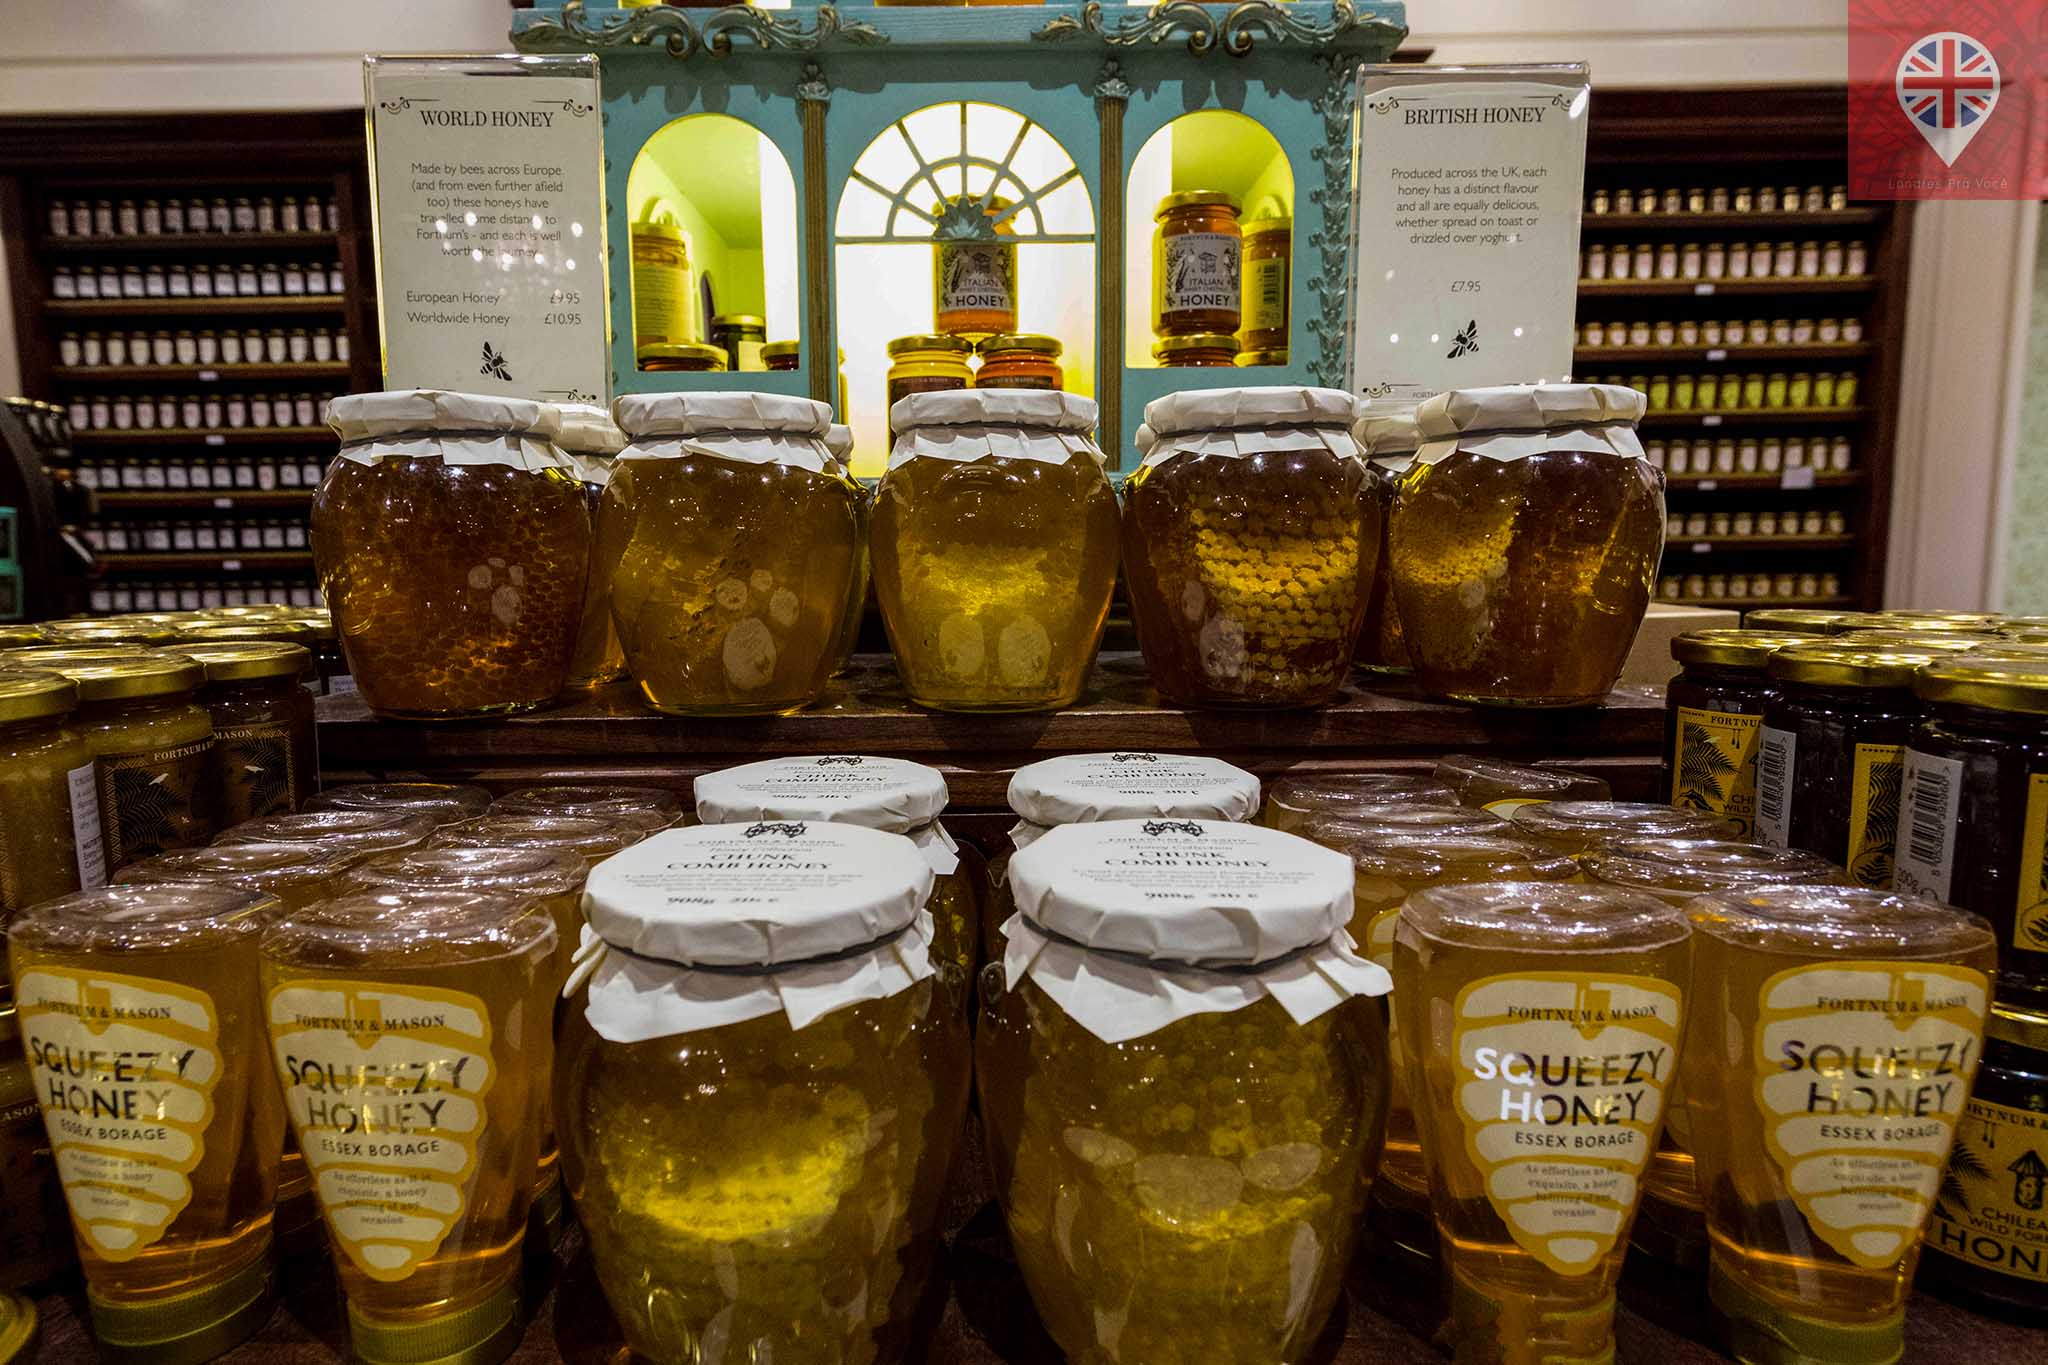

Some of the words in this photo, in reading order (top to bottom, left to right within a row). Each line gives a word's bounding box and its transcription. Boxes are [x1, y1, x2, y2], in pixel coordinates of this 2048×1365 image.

[420, 111, 487, 126] WORLD
[492, 111, 554, 127] HONEY
[1405, 108, 1478, 125] BRITISH
[1484, 107, 1546, 123] HONEY
[411, 163, 440, 175] Made
[445, 164, 457, 177] by
[460, 163, 484, 175] bees
[487, 166, 521, 176] across
[523, 164, 562, 178] Europe
[1391, 168, 1442, 179] Produced
[1446, 169, 1477, 178] across
[1481, 167, 1498, 177] the
[1502, 167, 1520, 178] UK,
[1523, 165, 1547, 177] each
[411, 179, 435, 192] (and
[438, 179, 463, 191] from
[467, 182, 492, 192] even
[494, 179, 531, 193] further
[535, 180, 564, 193] afield
[1398, 184, 1430, 198] honey
[1433, 184, 1451, 195] has
[1454, 186, 1461, 194] a
[1463, 183, 1501, 194] distinct
[1503, 182, 1539, 194] flavour
[427, 197, 450, 210] too)
[453, 196, 481, 208] these
[484, 196, 522, 211] honeys
[524, 197, 549, 209] have
[1396, 200, 1416, 211] and
[1419, 200, 1430, 211] all
[1433, 203, 1450, 211] are
[1453, 199, 1489, 213] equally
[1492, 199, 1540, 211] delicious,
[545, 216, 557, 225] to
[1396, 216, 1439, 228] whether
[1442, 217, 1477, 230] spread
[1479, 218, 1494, 227] on
[1497, 216, 1523, 227] toast
[1526, 217, 1539, 226] or
[479, 230, 500, 241] and
[502, 230, 528, 241] each
[530, 230, 537, 240] is
[539, 230, 561, 241] well
[1409, 232, 1450, 244] drizzled
[1453, 234, 1477, 243] over
[441, 245, 472, 257] worth
[478, 246, 495, 256] he
[964, 279, 999, 288] ITALIAN
[1188, 278, 1224, 287] ITALIAN
[1451, 280, 1481, 293] £7.95
[406, 290, 460, 304] European
[462, 291, 500, 306] Honey
[955, 294, 1006, 307] HONEY
[1179, 294, 1230, 307] HONEY
[406, 311, 470, 324] Worldwide
[473, 312, 511, 328] Honey
[544, 313, 582, 325] £10.95
[1731, 794, 1755, 805] CHI
[1722, 803, 1752, 814] WILD
[710, 853, 797, 861] CHUNK
[1138, 851, 1226, 859] CHUNK
[666, 862, 741, 870] COMB
[744, 861, 834, 870] HONEY
[1104, 859, 1179, 867] COMB
[1184, 859, 1272, 868] HONEY
[1816, 996, 1906, 1013] FORTNUM
[113, 1006, 172, 1020] MASON
[1507, 1006, 1592, 1022] FORTNUM
[1595, 1011, 1605, 1022] &
[1611, 1004, 1658, 1021] MASON
[295, 1013, 364, 1033] FORTNUM
[369, 1021, 381, 1032] &
[384, 1013, 446, 1031] MASON
[30, 1036, 195, 1084] SQUEEZY
[1781, 1037, 1973, 1081] SQUEEZY
[286, 1055, 470, 1098] SQUEEZY
[1472, 1047, 1666, 1090] SQUEEZY
[49, 1077, 172, 1121] HONEY
[1807, 1081, 1953, 1119] HONEY
[0, 1104, 40, 1121] ASO
[1500, 1088, 1646, 1127] HONEY
[1967, 1103, 2037, 1128] RTNUM
[308, 1096, 447, 1136] HONEY
[97, 1127, 168, 1142] BORAGE
[1515, 1131, 1567, 1149] ESSEX
[1575, 1131, 1634, 1149] BORAGE
[1820, 1124, 1877, 1142] ESSEX
[1883, 1122, 1941, 1142] BORAGE
[322, 1138, 363, 1157] ESSEX
[369, 1140, 440, 1157] BORAGE
[1968, 1215, 2009, 1235] WILD
[1981, 1206, 2048, 1232] CHILEA
[1940, 1223, 2048, 1275] HON
